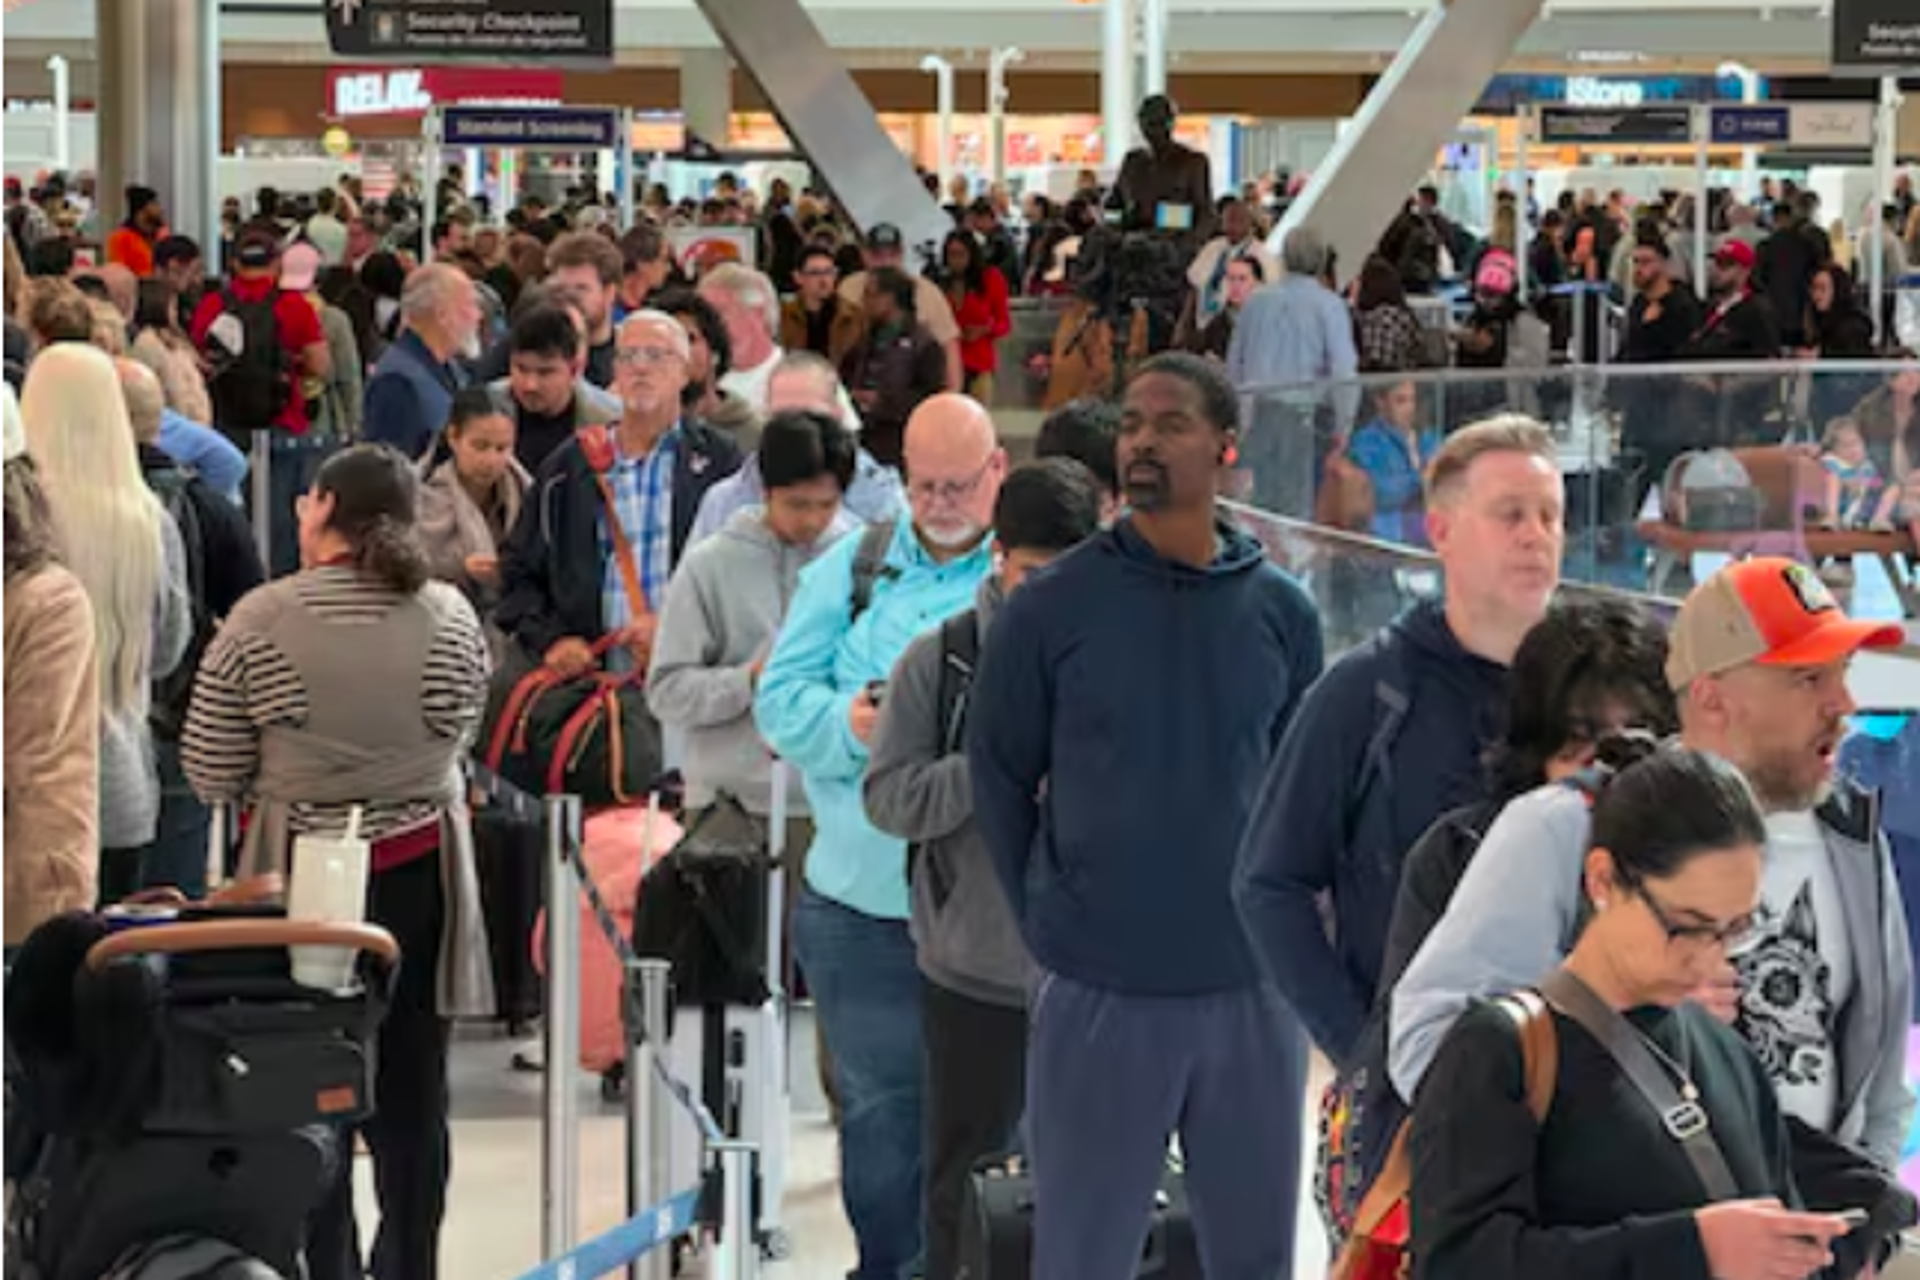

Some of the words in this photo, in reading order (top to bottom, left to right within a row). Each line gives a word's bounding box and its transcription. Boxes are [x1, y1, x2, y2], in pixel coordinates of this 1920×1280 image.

[408, 12, 476, 33] Security
[482, 12, 581, 33] Checkpoint
[457, 117, 524, 136] Standard
[527, 118, 604, 140] Screening
